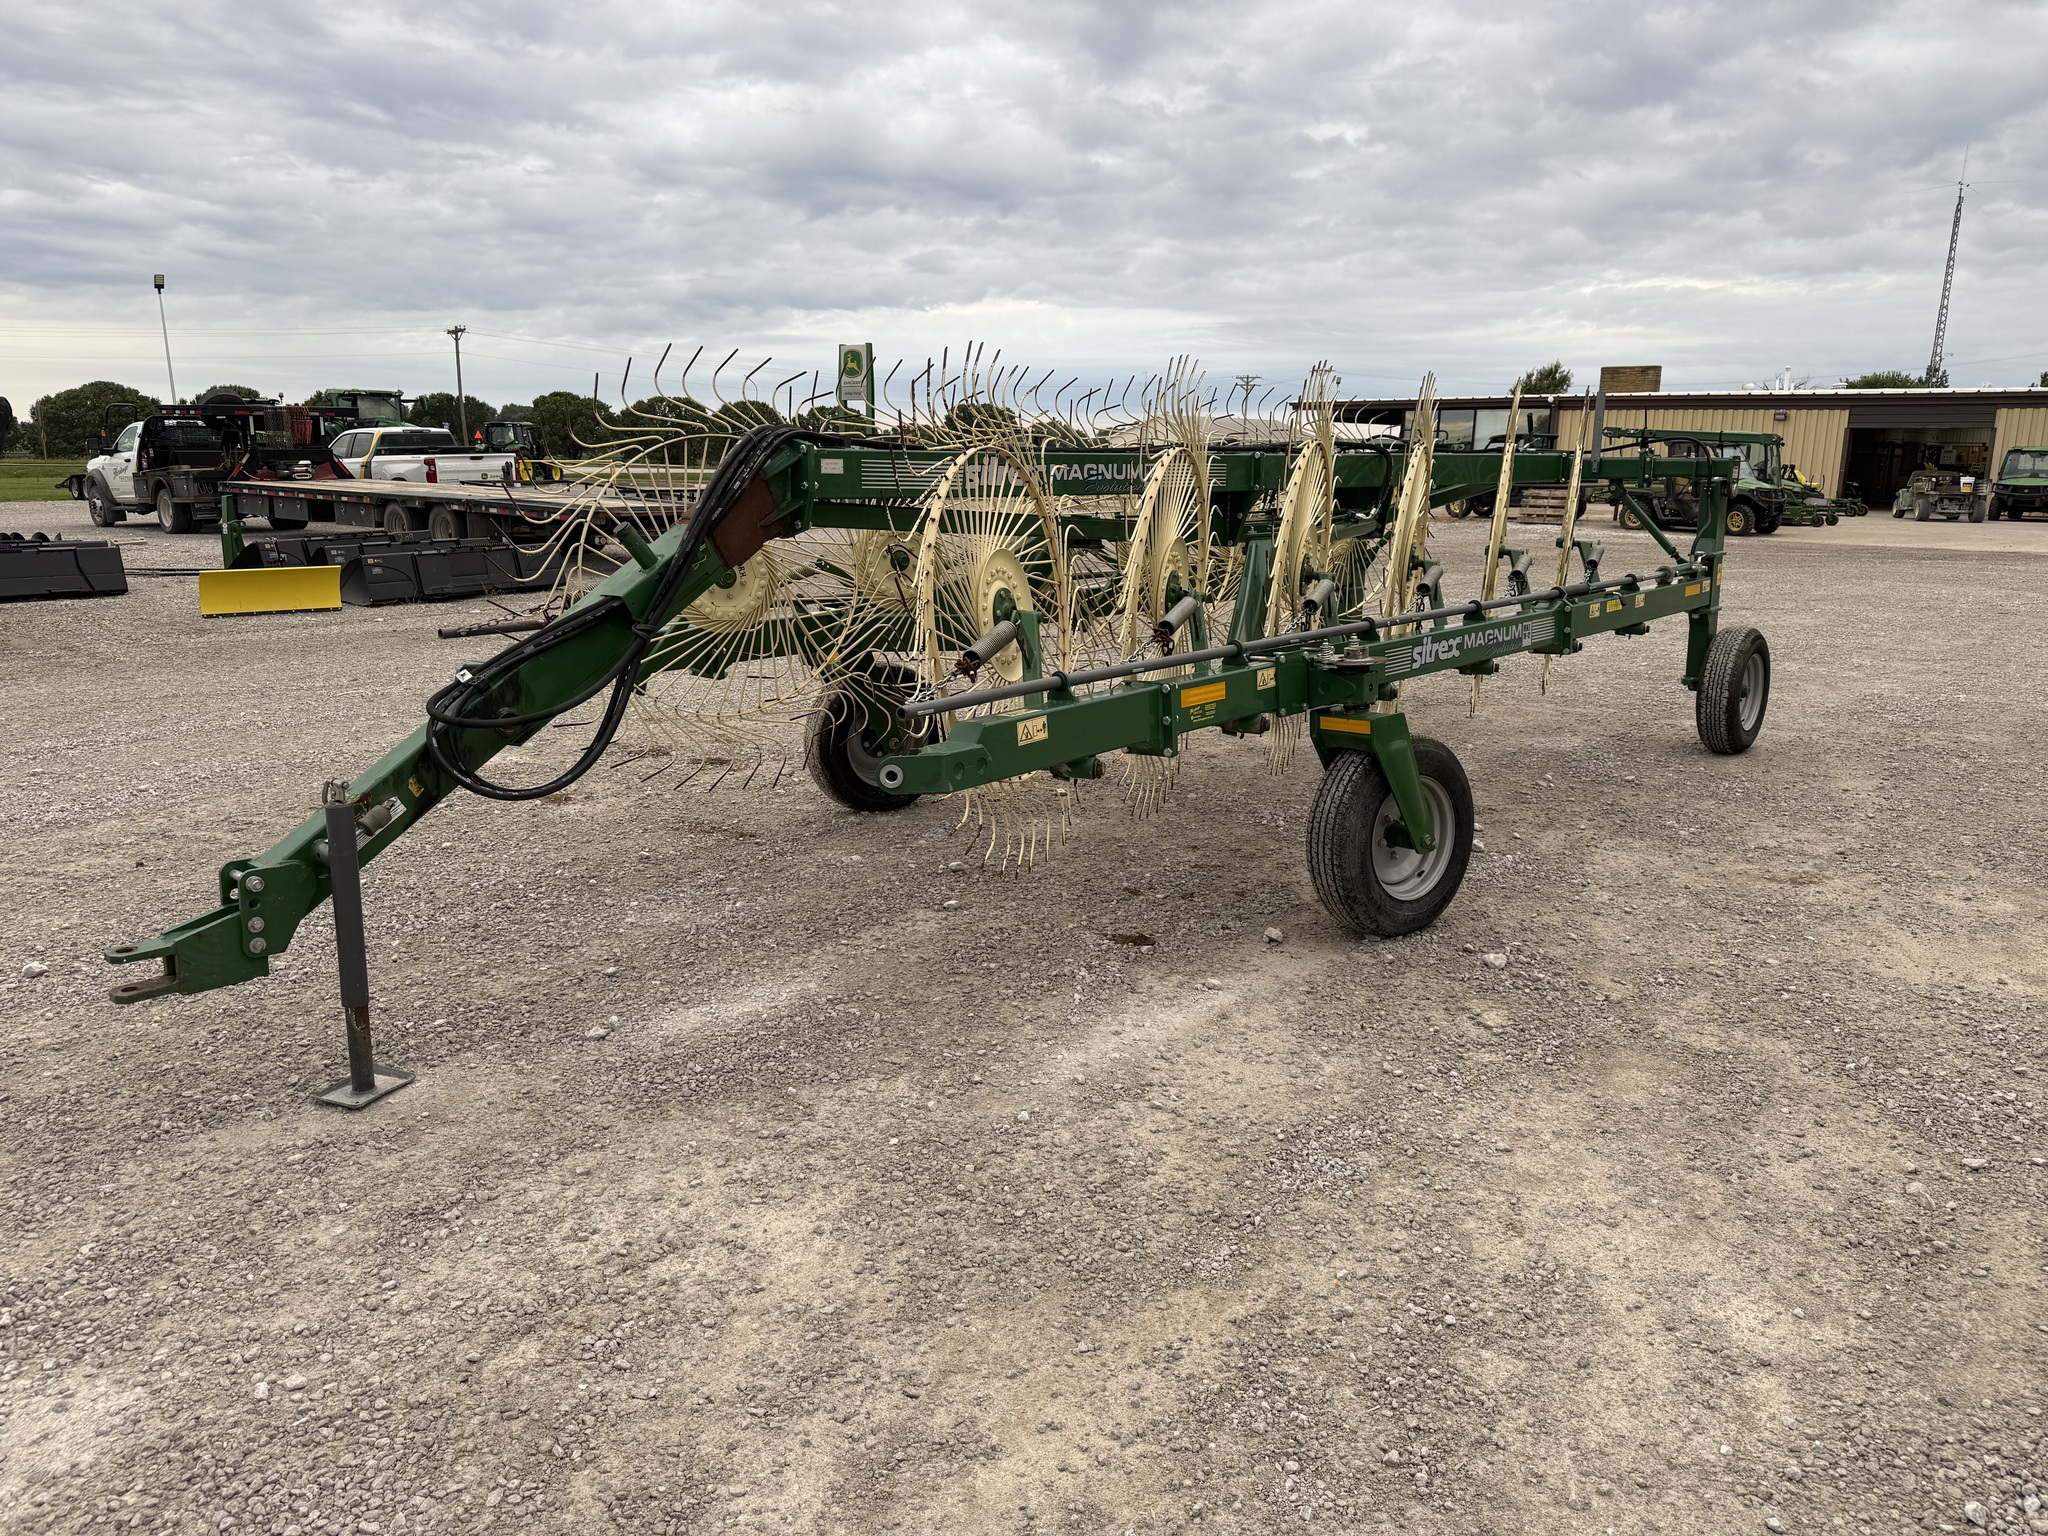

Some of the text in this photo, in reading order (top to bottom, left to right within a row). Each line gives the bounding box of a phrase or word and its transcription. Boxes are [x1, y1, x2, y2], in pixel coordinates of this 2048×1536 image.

[1050, 463, 1143, 480] MAGNUM
[1412, 635, 1463, 670] sitrex
[1464, 623, 1523, 650] MAGNUM
